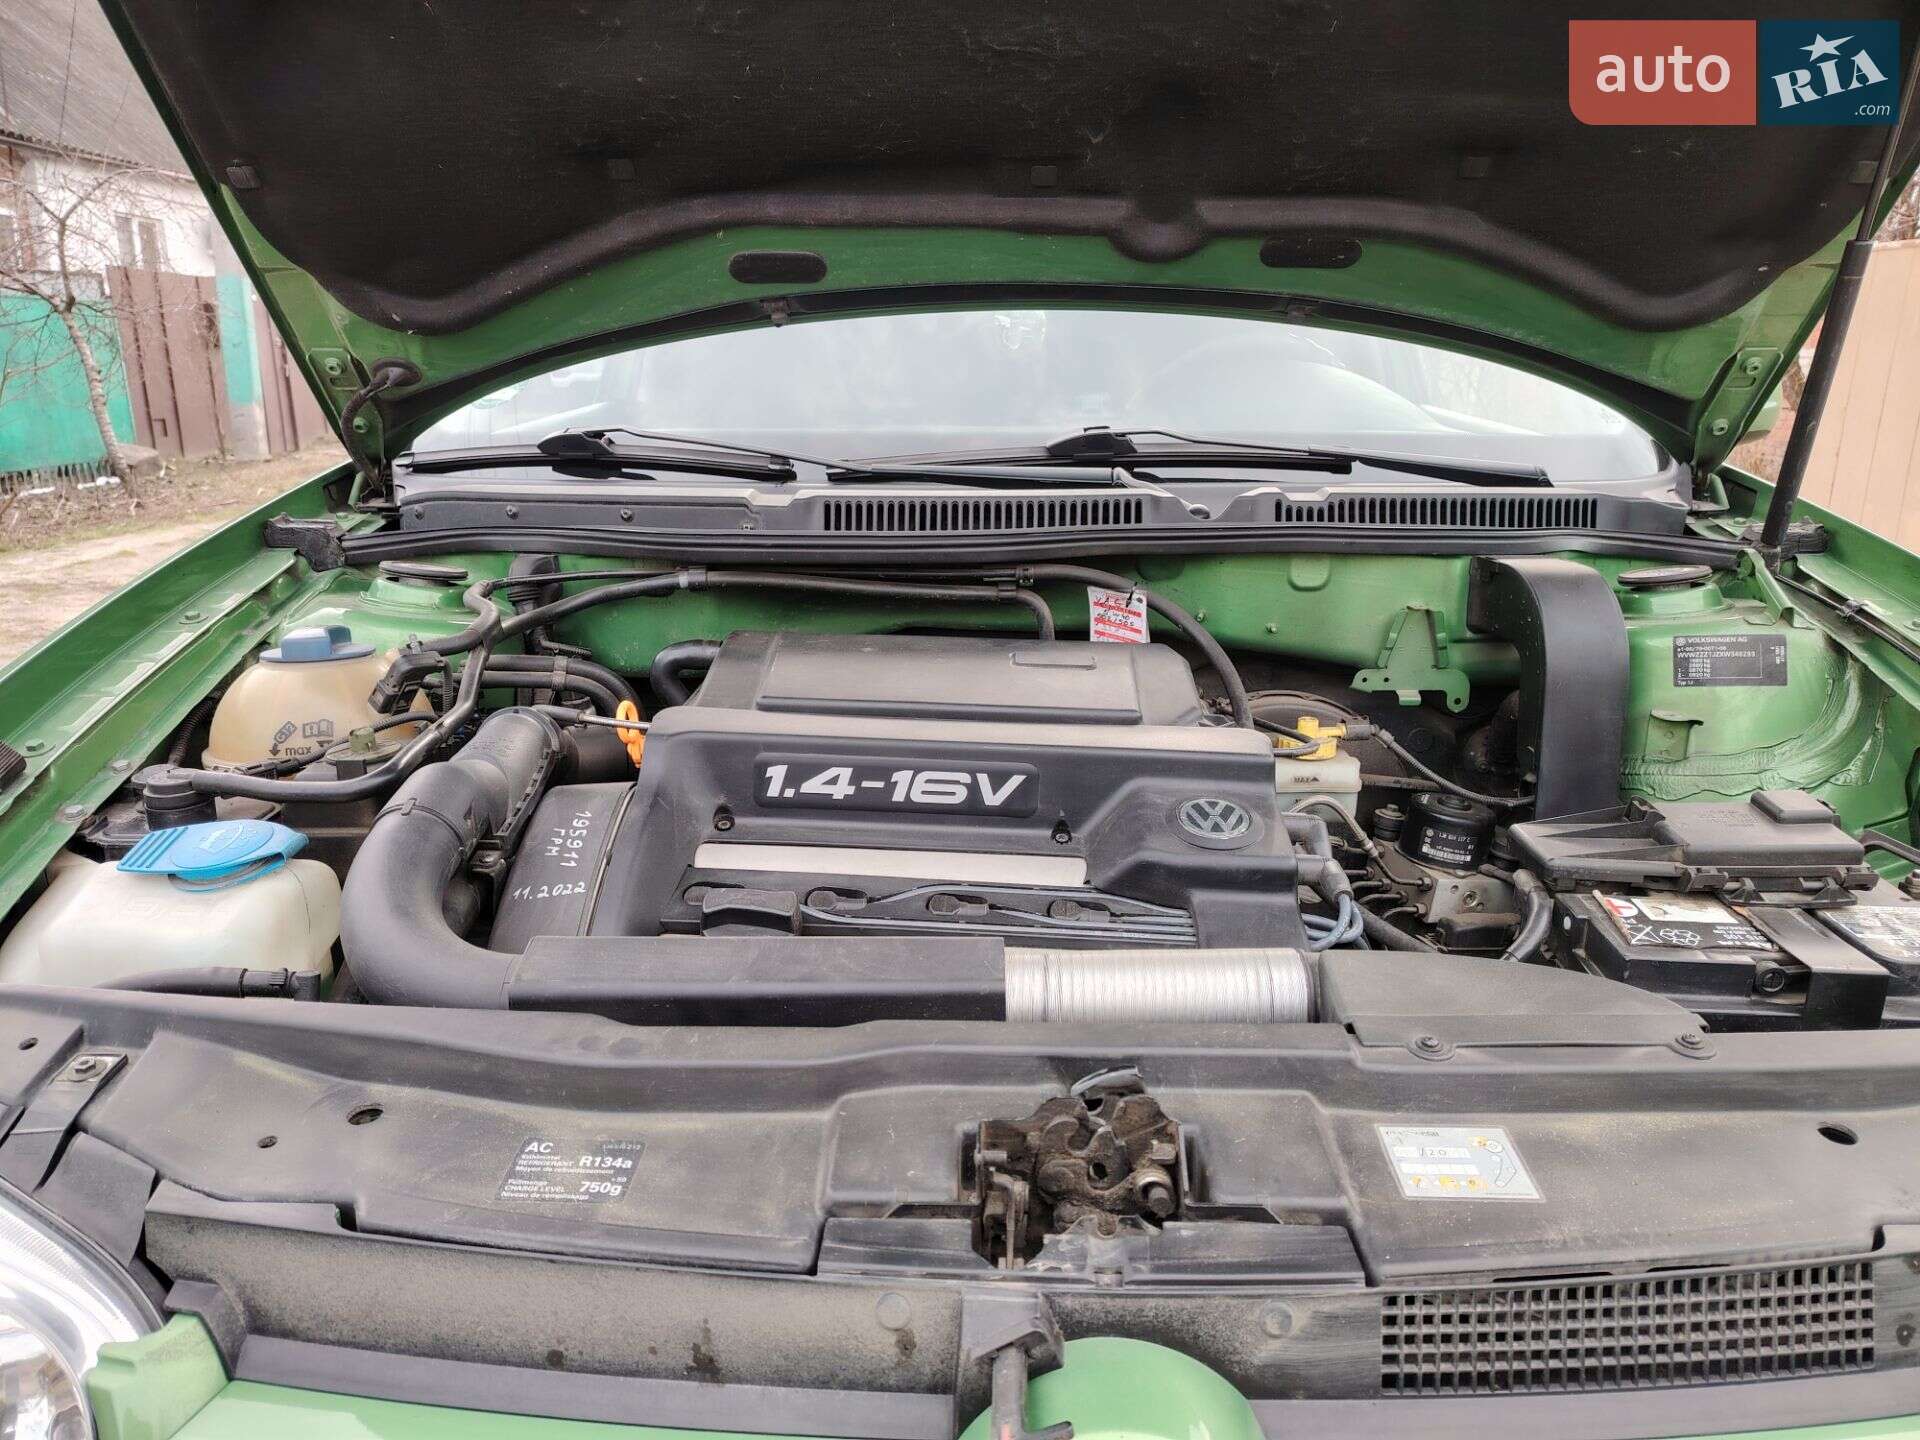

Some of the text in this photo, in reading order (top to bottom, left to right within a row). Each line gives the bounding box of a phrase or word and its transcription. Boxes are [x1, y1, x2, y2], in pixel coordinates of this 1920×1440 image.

[285, 746, 312, 756] max
[765, 764, 1028, 806] 1.4-16V
[560, 810, 593, 867] 195911
[512, 881, 587, 900] 11.2022
[525, 1141, 554, 1153] AC
[579, 1155, 633, 1169] R134a
[579, 1181, 623, 1196] 750g
